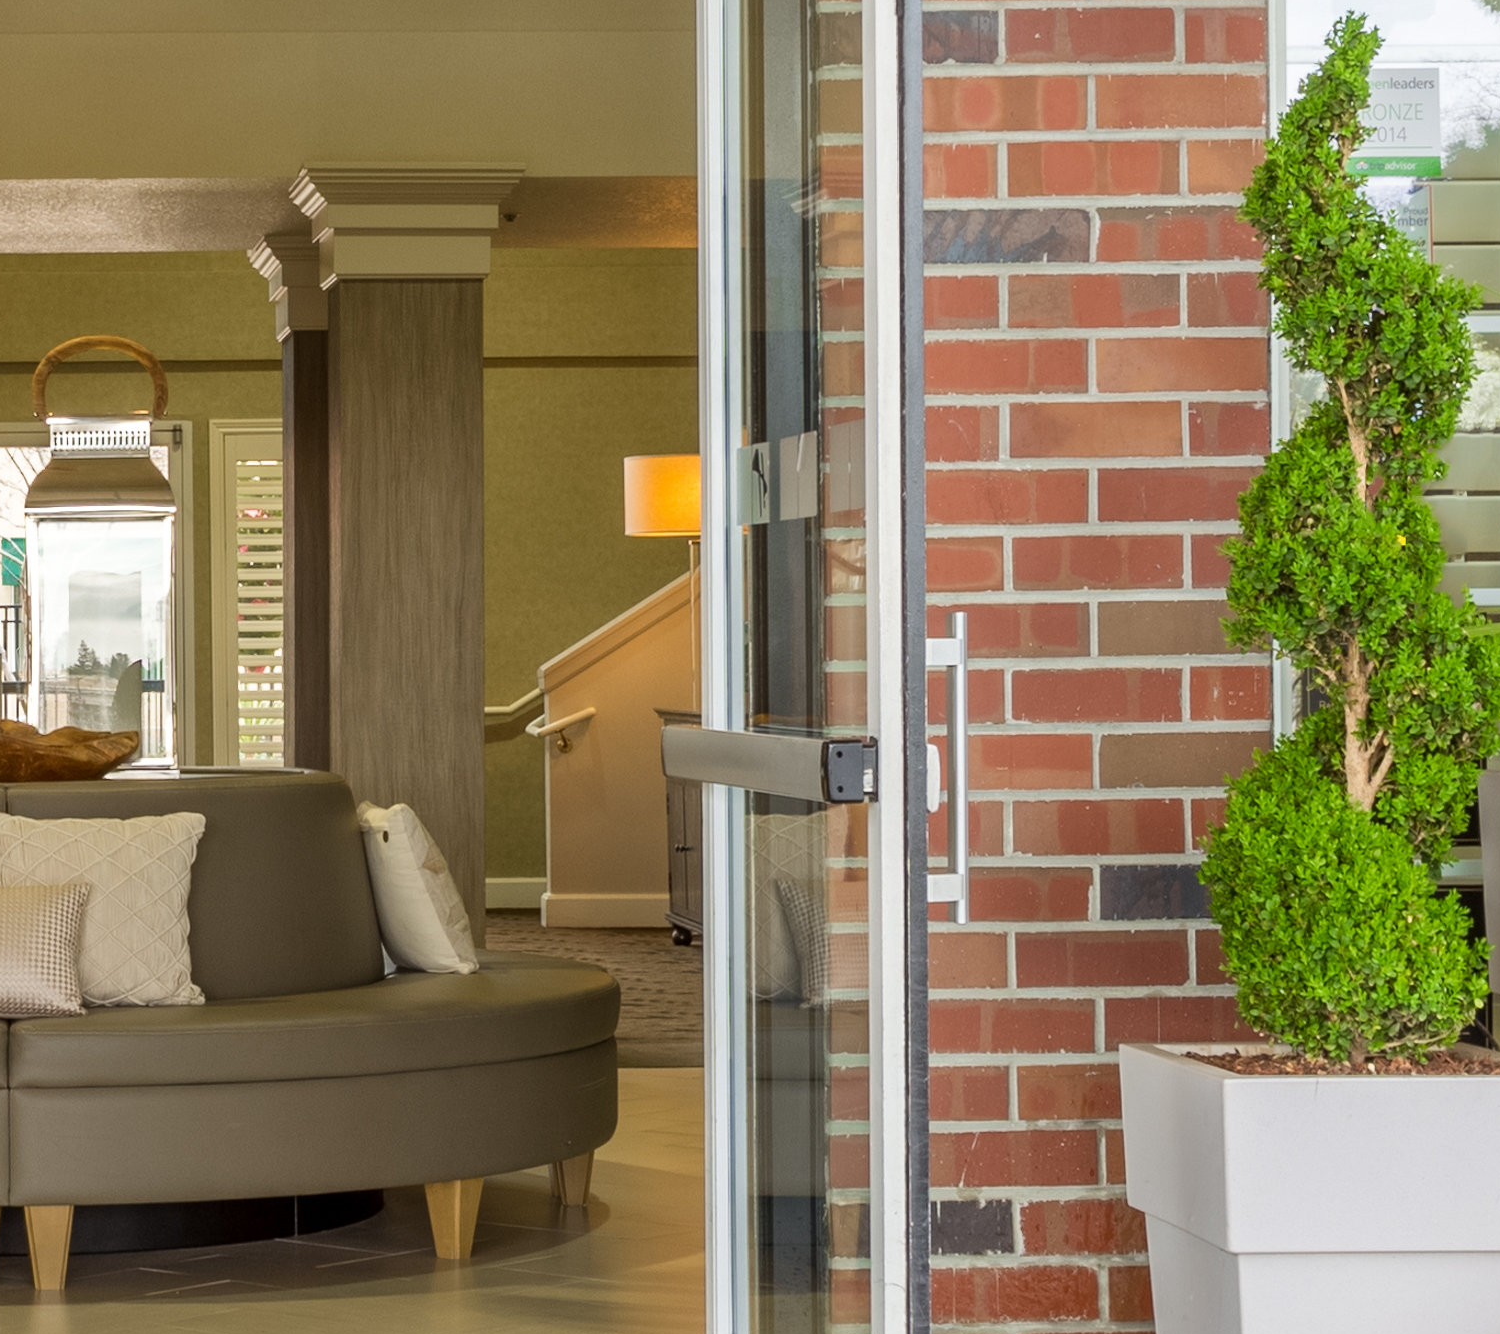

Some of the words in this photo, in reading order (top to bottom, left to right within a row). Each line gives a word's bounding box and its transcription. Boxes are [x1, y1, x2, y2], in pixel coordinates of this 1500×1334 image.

[1370, 76, 1435, 90] enleaders
[1361, 102, 1425, 121] RONZE
[1398, 216, 1429, 227] mber
